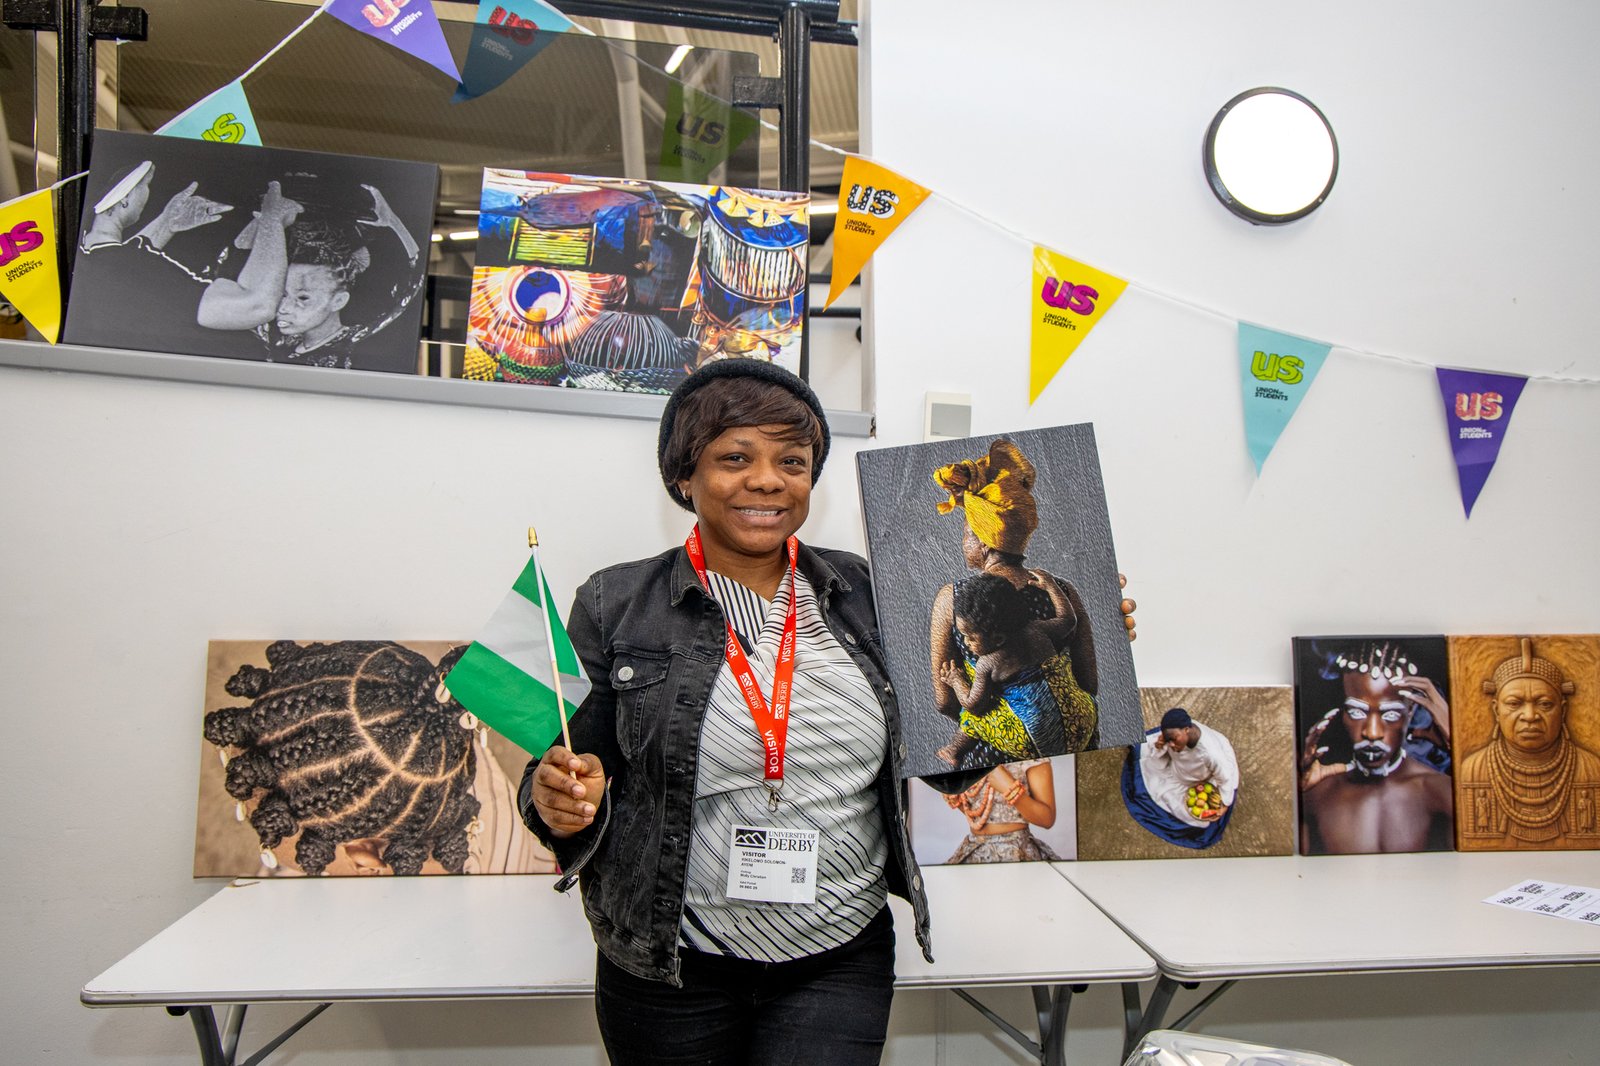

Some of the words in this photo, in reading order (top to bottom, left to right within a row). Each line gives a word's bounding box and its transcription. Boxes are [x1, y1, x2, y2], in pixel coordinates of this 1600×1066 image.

[845, 224, 876, 235] STUDENTS
[846, 219, 867, 228] UNION
[5, 261, 30, 277] UNION
[8, 260, 43, 283] STUDENTS
[1044, 312, 1068, 322] UNION
[1043, 317, 1077, 331] STUDENTS
[1255, 391, 1289, 401] STUDENTS
[1256, 386, 1279, 394] UNION
[1459, 431, 1492, 439] STUDENTS
[781, 630, 793, 663] VISITOR
[745, 686, 761, 710] DERBY
[780, 680, 788, 703] DERBY
[764, 729, 779, 773] VISITOR
[768, 831, 807, 839] UNIVERSITY
[768, 838, 815, 851] DERBY
